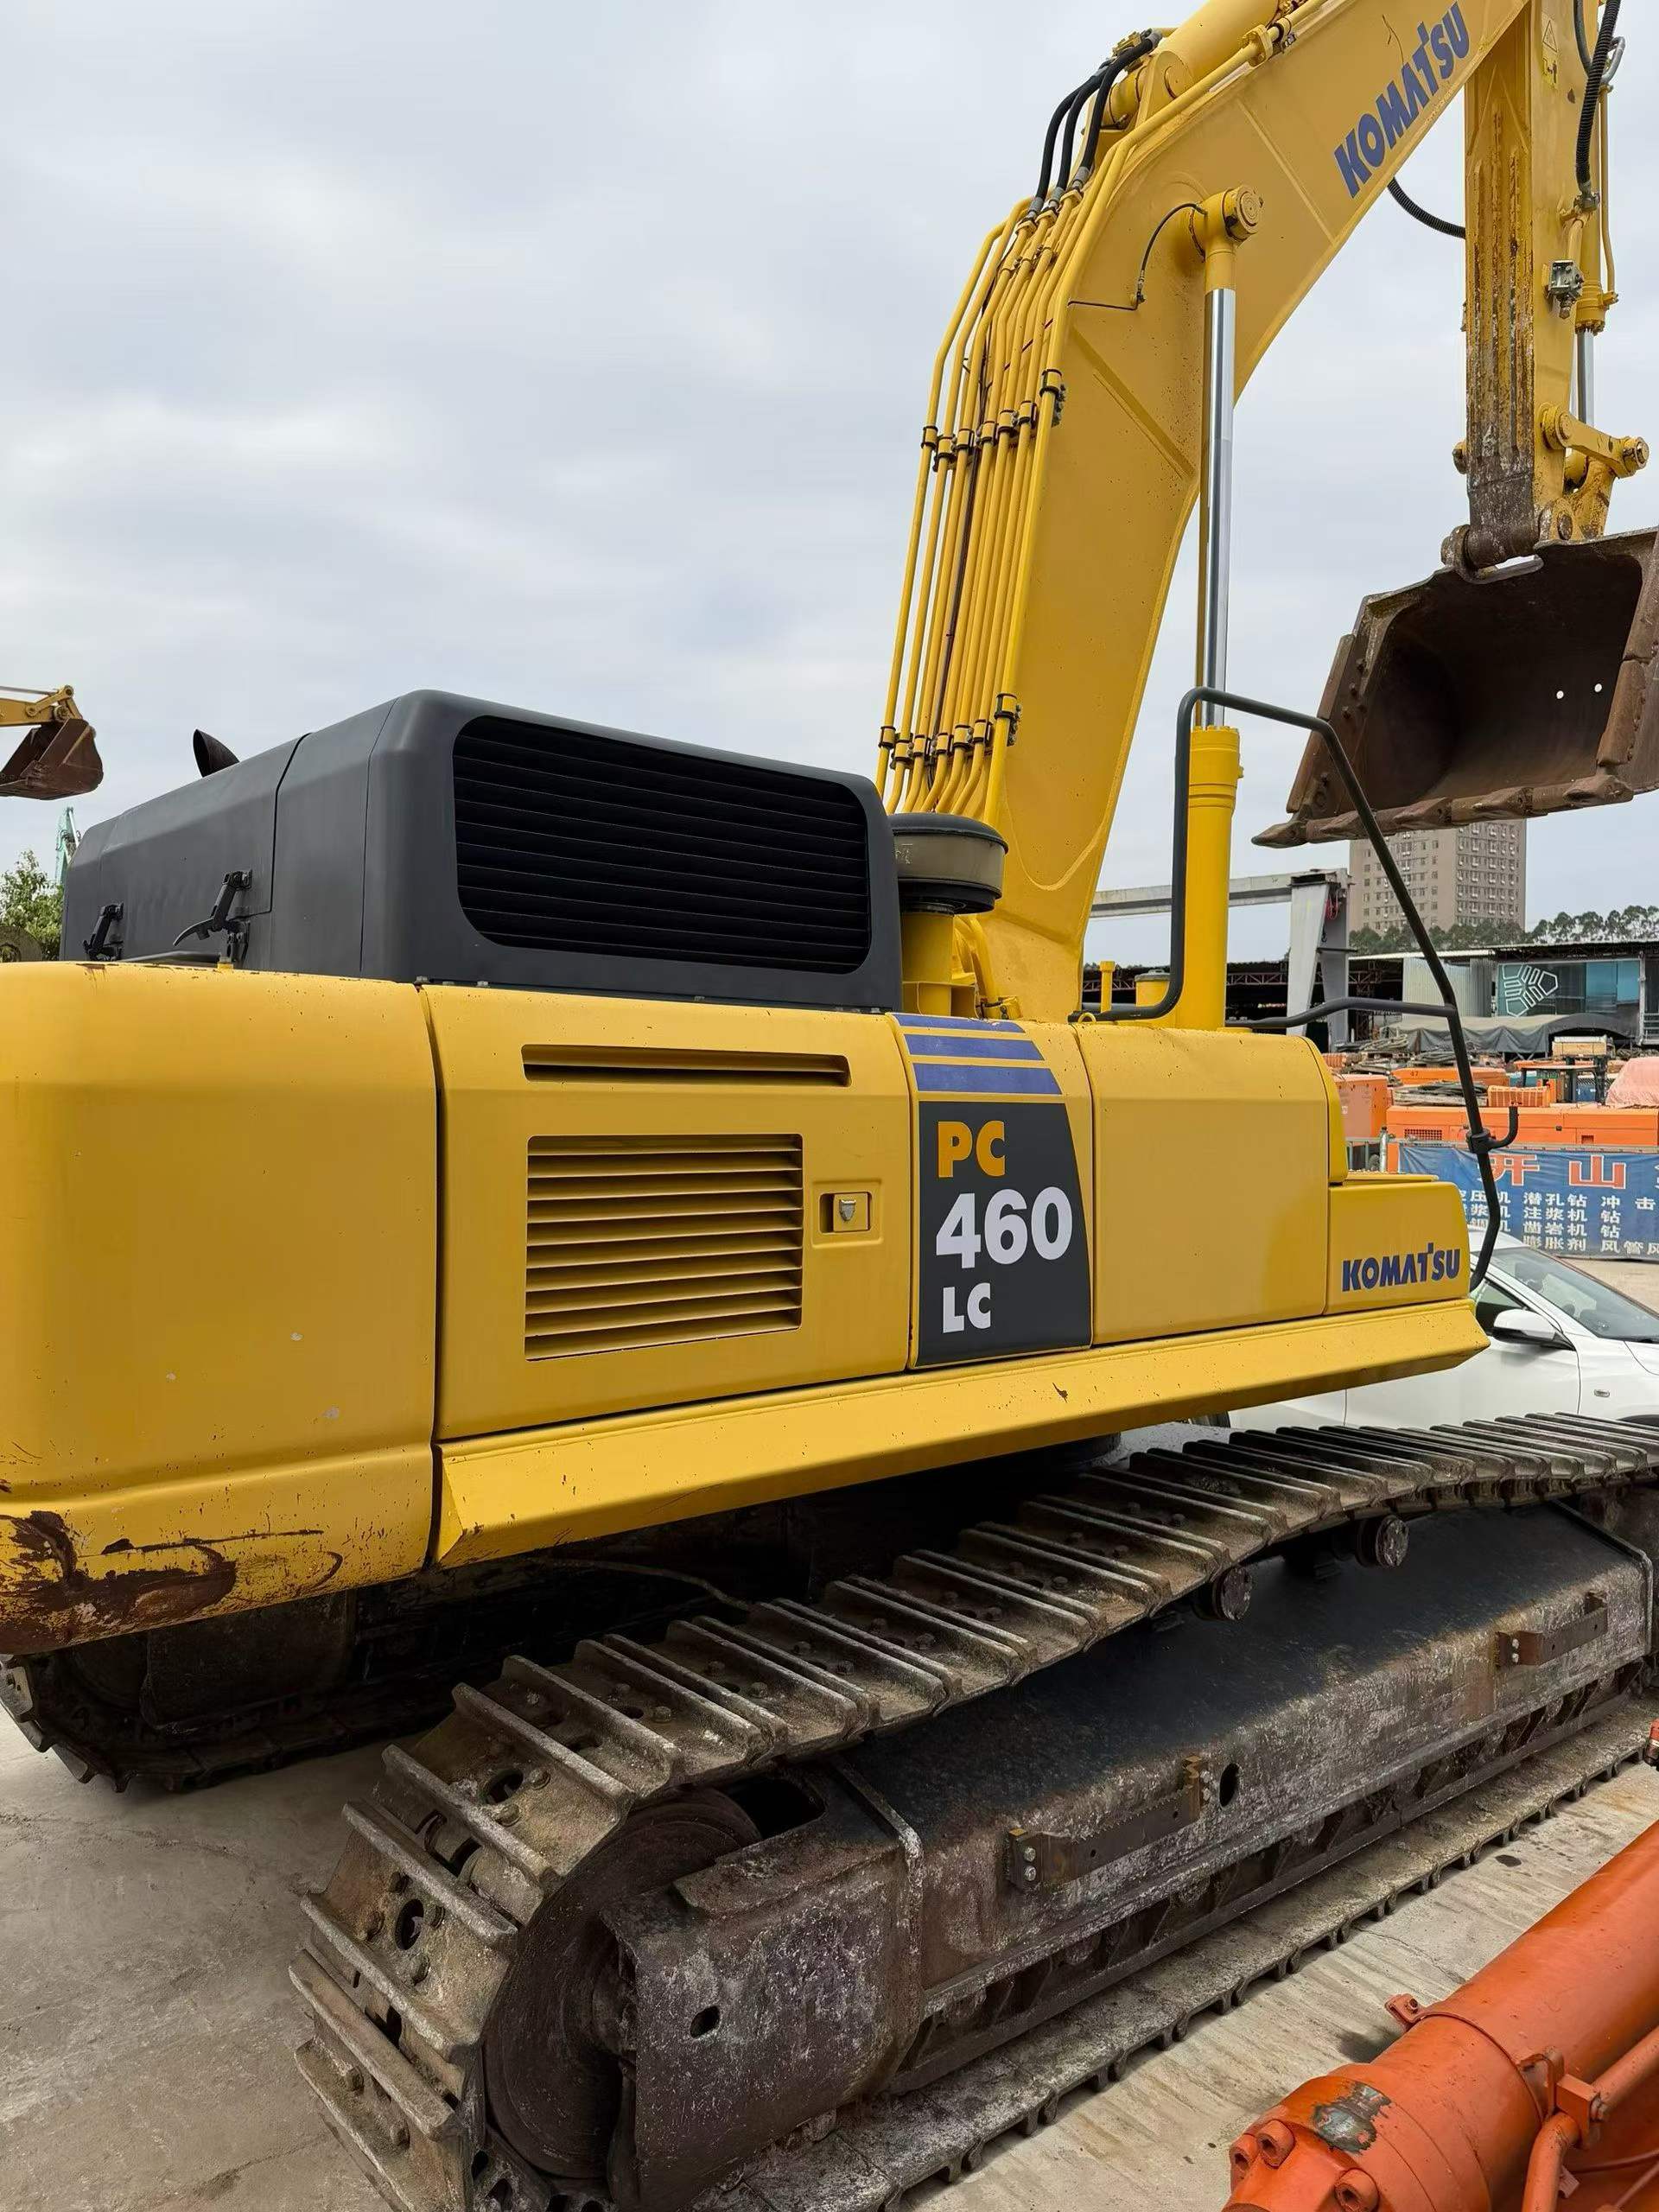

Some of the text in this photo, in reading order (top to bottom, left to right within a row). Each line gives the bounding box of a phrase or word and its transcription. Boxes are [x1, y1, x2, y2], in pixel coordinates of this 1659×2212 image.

[1334, 3, 1470, 198] KOMATSU
[938, 1120, 1005, 1178] PC
[1523, 1192, 1588, 1207] 潜孔钻
[1523, 1206, 1588, 1221] 注浆机
[936, 1186, 1073, 1268] 460
[1342, 1242, 1460, 1292] KOMATSU
[943, 1282, 991, 1333] LC
